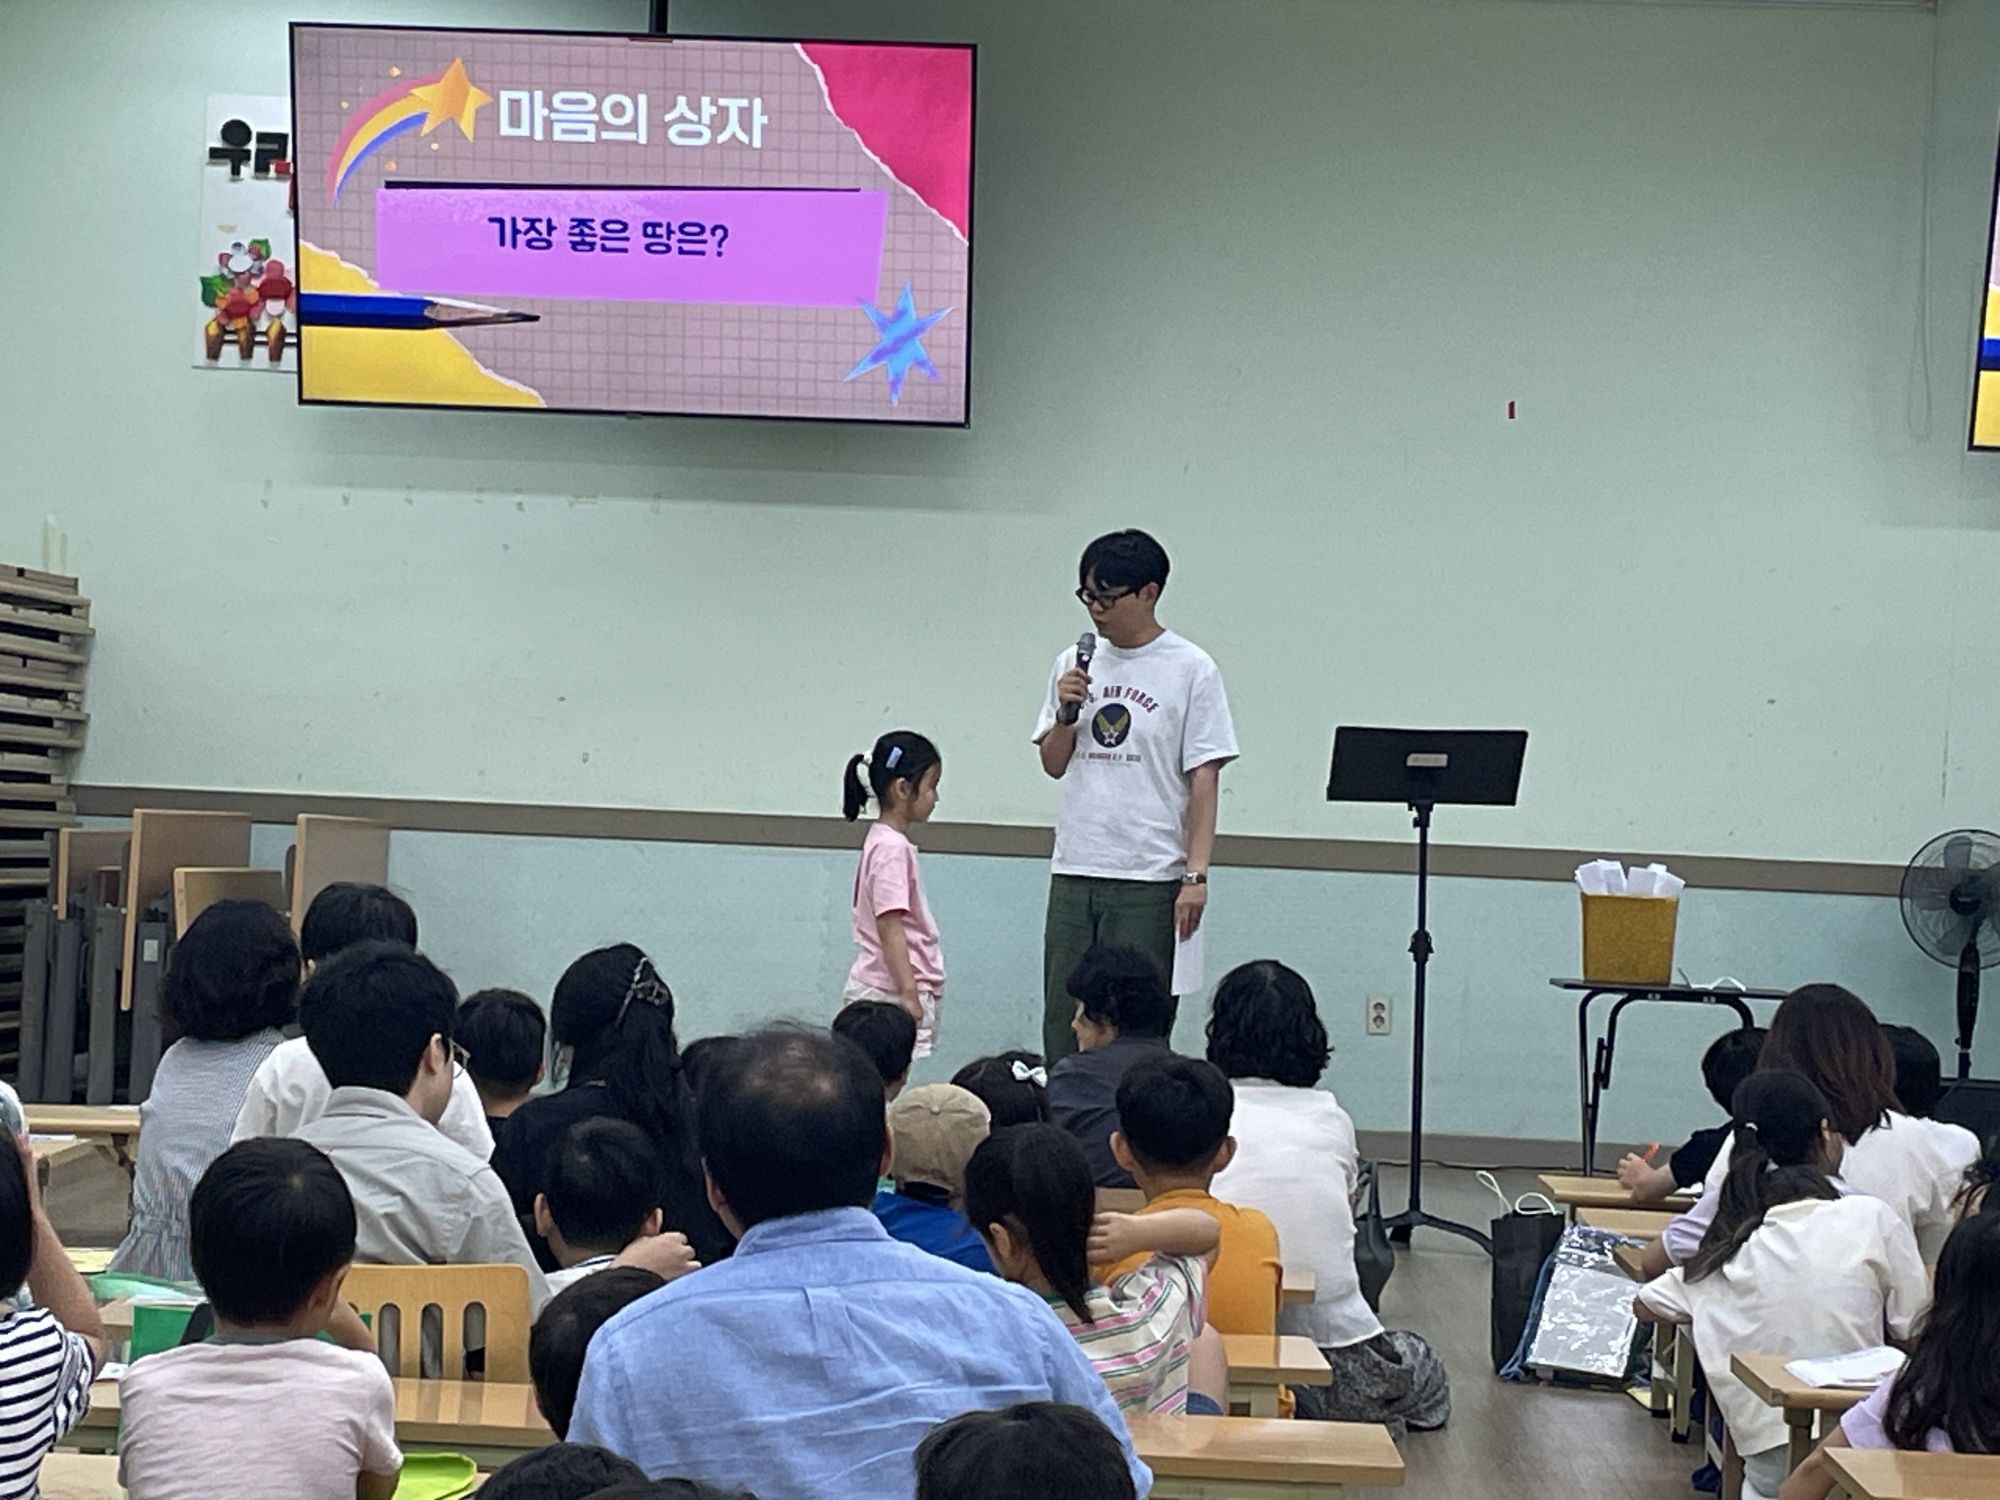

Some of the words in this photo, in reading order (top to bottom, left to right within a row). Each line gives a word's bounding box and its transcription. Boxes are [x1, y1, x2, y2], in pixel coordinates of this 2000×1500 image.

[499, 90, 648, 145] 마음의
[664, 95, 769, 149] 상자
[487, 216, 558, 251] 가장
[568, 217, 631, 254] 좋은
[642, 220, 730, 258] 땅은?
[1103, 685, 1122, 698] AIR
[1124, 686, 1159, 713] FORCE
